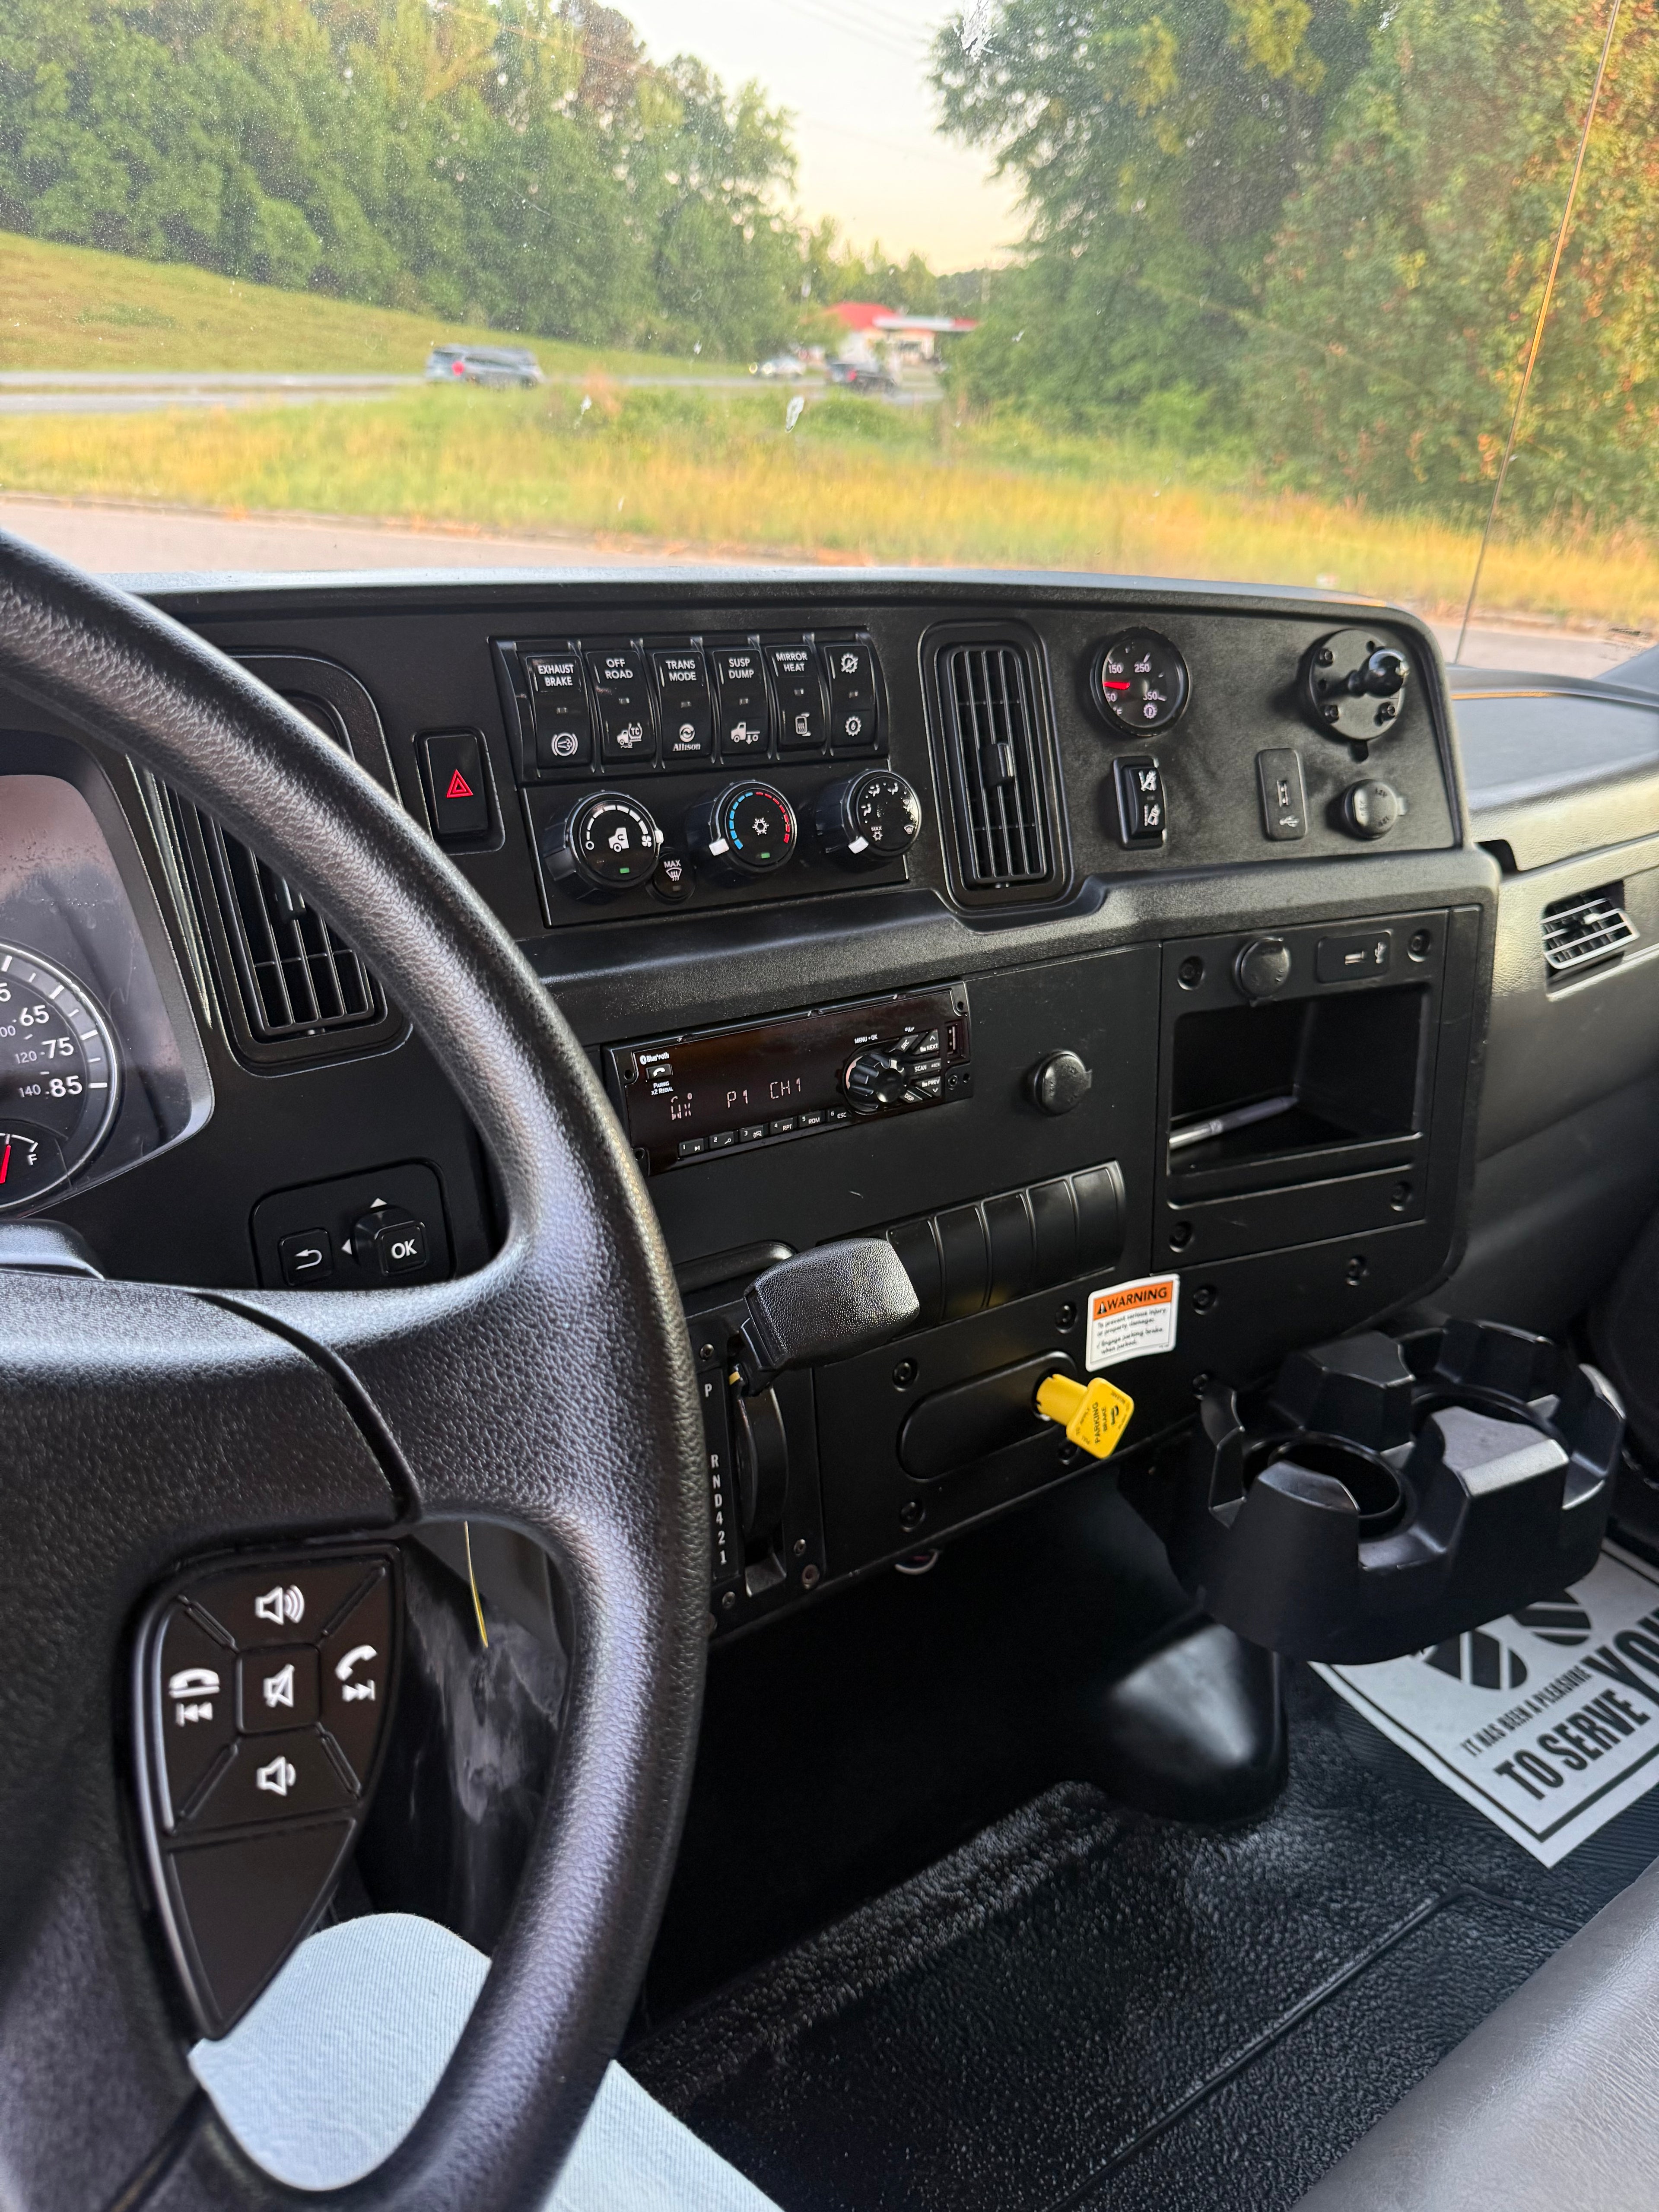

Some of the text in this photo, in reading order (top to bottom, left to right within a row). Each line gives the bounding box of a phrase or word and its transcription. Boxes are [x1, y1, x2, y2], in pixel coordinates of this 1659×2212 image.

[775, 652, 808, 661] MIRROR
[606, 658, 625, 667] OFF
[666, 660, 695, 670] TRANS
[728, 658, 750, 667] SUSP
[783, 663, 804, 672] HEAT
[1134, 663, 1150, 673] 250
[537, 664, 574, 674] EXHAUST
[1109, 663, 1123, 674] 150
[605, 670, 633, 679] ROAD
[669, 672, 696, 681] MODE
[729, 670, 754, 679] DUMP
[545, 676, 572, 686] BRAKE
[630, 727, 640, 735] TC
[673, 743, 701, 751] Allison
[664, 859, 681, 868] MAX
[20, 1005, 49, 1026] 65
[41, 1037, 74, 1058] 75
[901, 1039, 909, 1050] SRC
[15, 1050, 37, 1064] 120
[19, 1084, 41, 1097] 140
[49, 1075, 83, 1097] 85
[27, 1154, 37, 1166] F
[391, 1239, 417, 1259] OK
[1107, 1287, 1167, 1310] WARNING
[705, 1383, 712, 1398] P
[711, 1454, 719, 1469] R
[712, 1475, 721, 1489] N
[714, 1494, 722, 1508] D
[716, 1511, 724, 1526] 4
[718, 1531, 726, 1545] 2
[720, 1551, 727, 1565] 1
[1494, 1748, 1564, 1800] TO
[1537, 1688, 1651, 1770] SERVE
